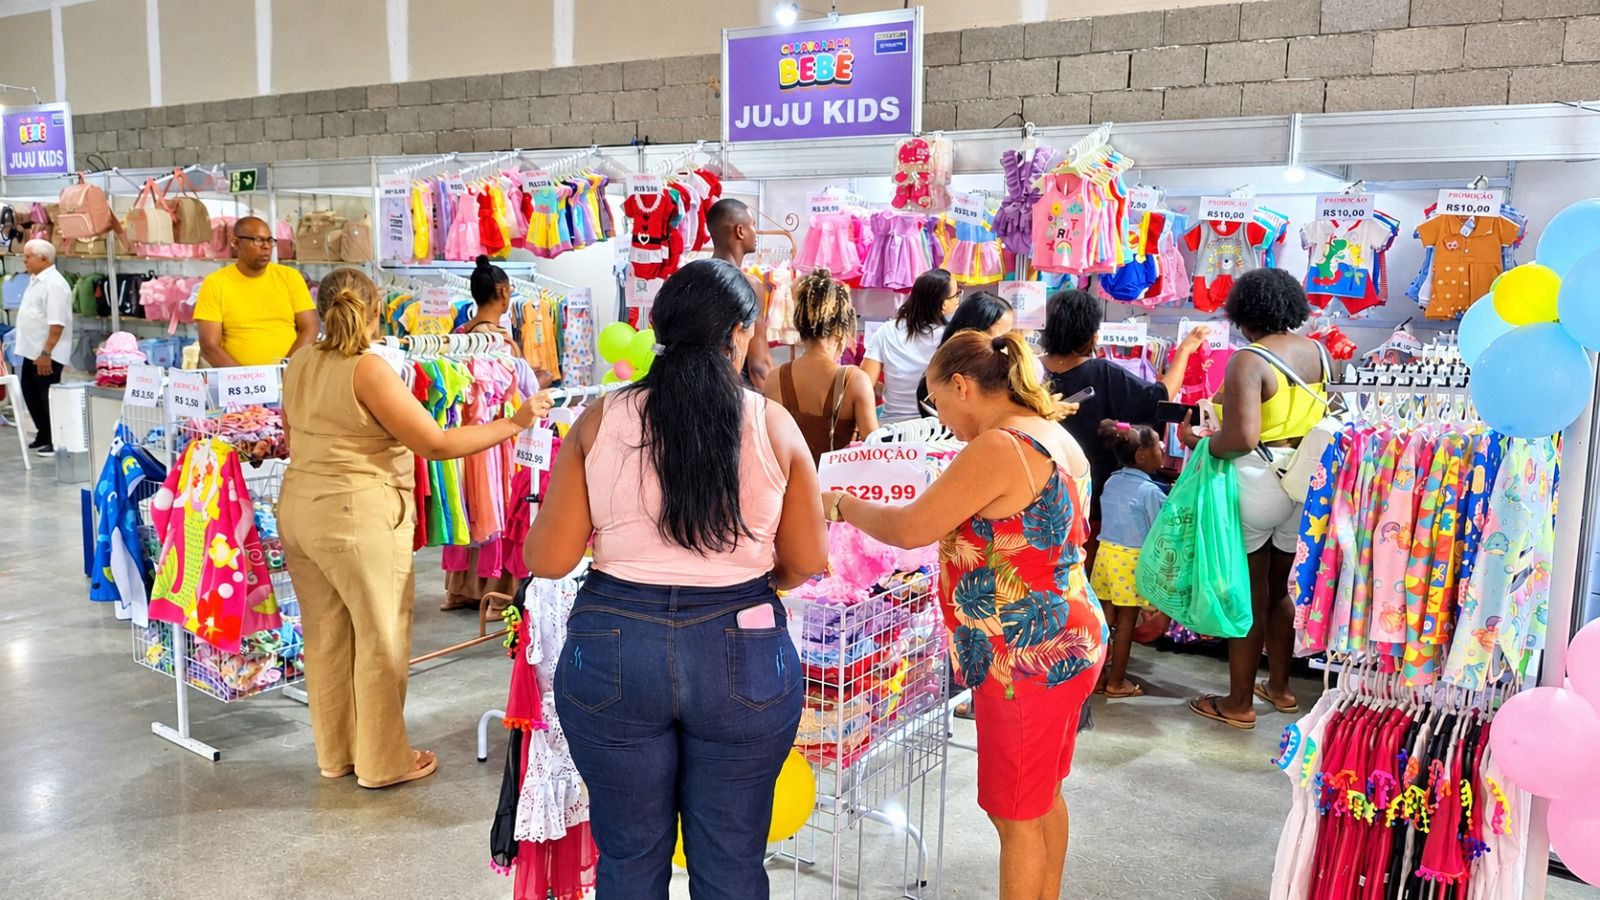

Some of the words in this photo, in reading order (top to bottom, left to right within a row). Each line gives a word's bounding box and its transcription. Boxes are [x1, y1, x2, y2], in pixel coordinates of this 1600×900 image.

[735, 102, 812, 129] JUJU
[823, 96, 901, 125] KIDS
[9, 151, 36, 169] JUJU
[38, 149, 65, 168] KIDS
[244, 384, 267, 396] 3,50
[828, 446, 918, 464] PROMOÇÃO
